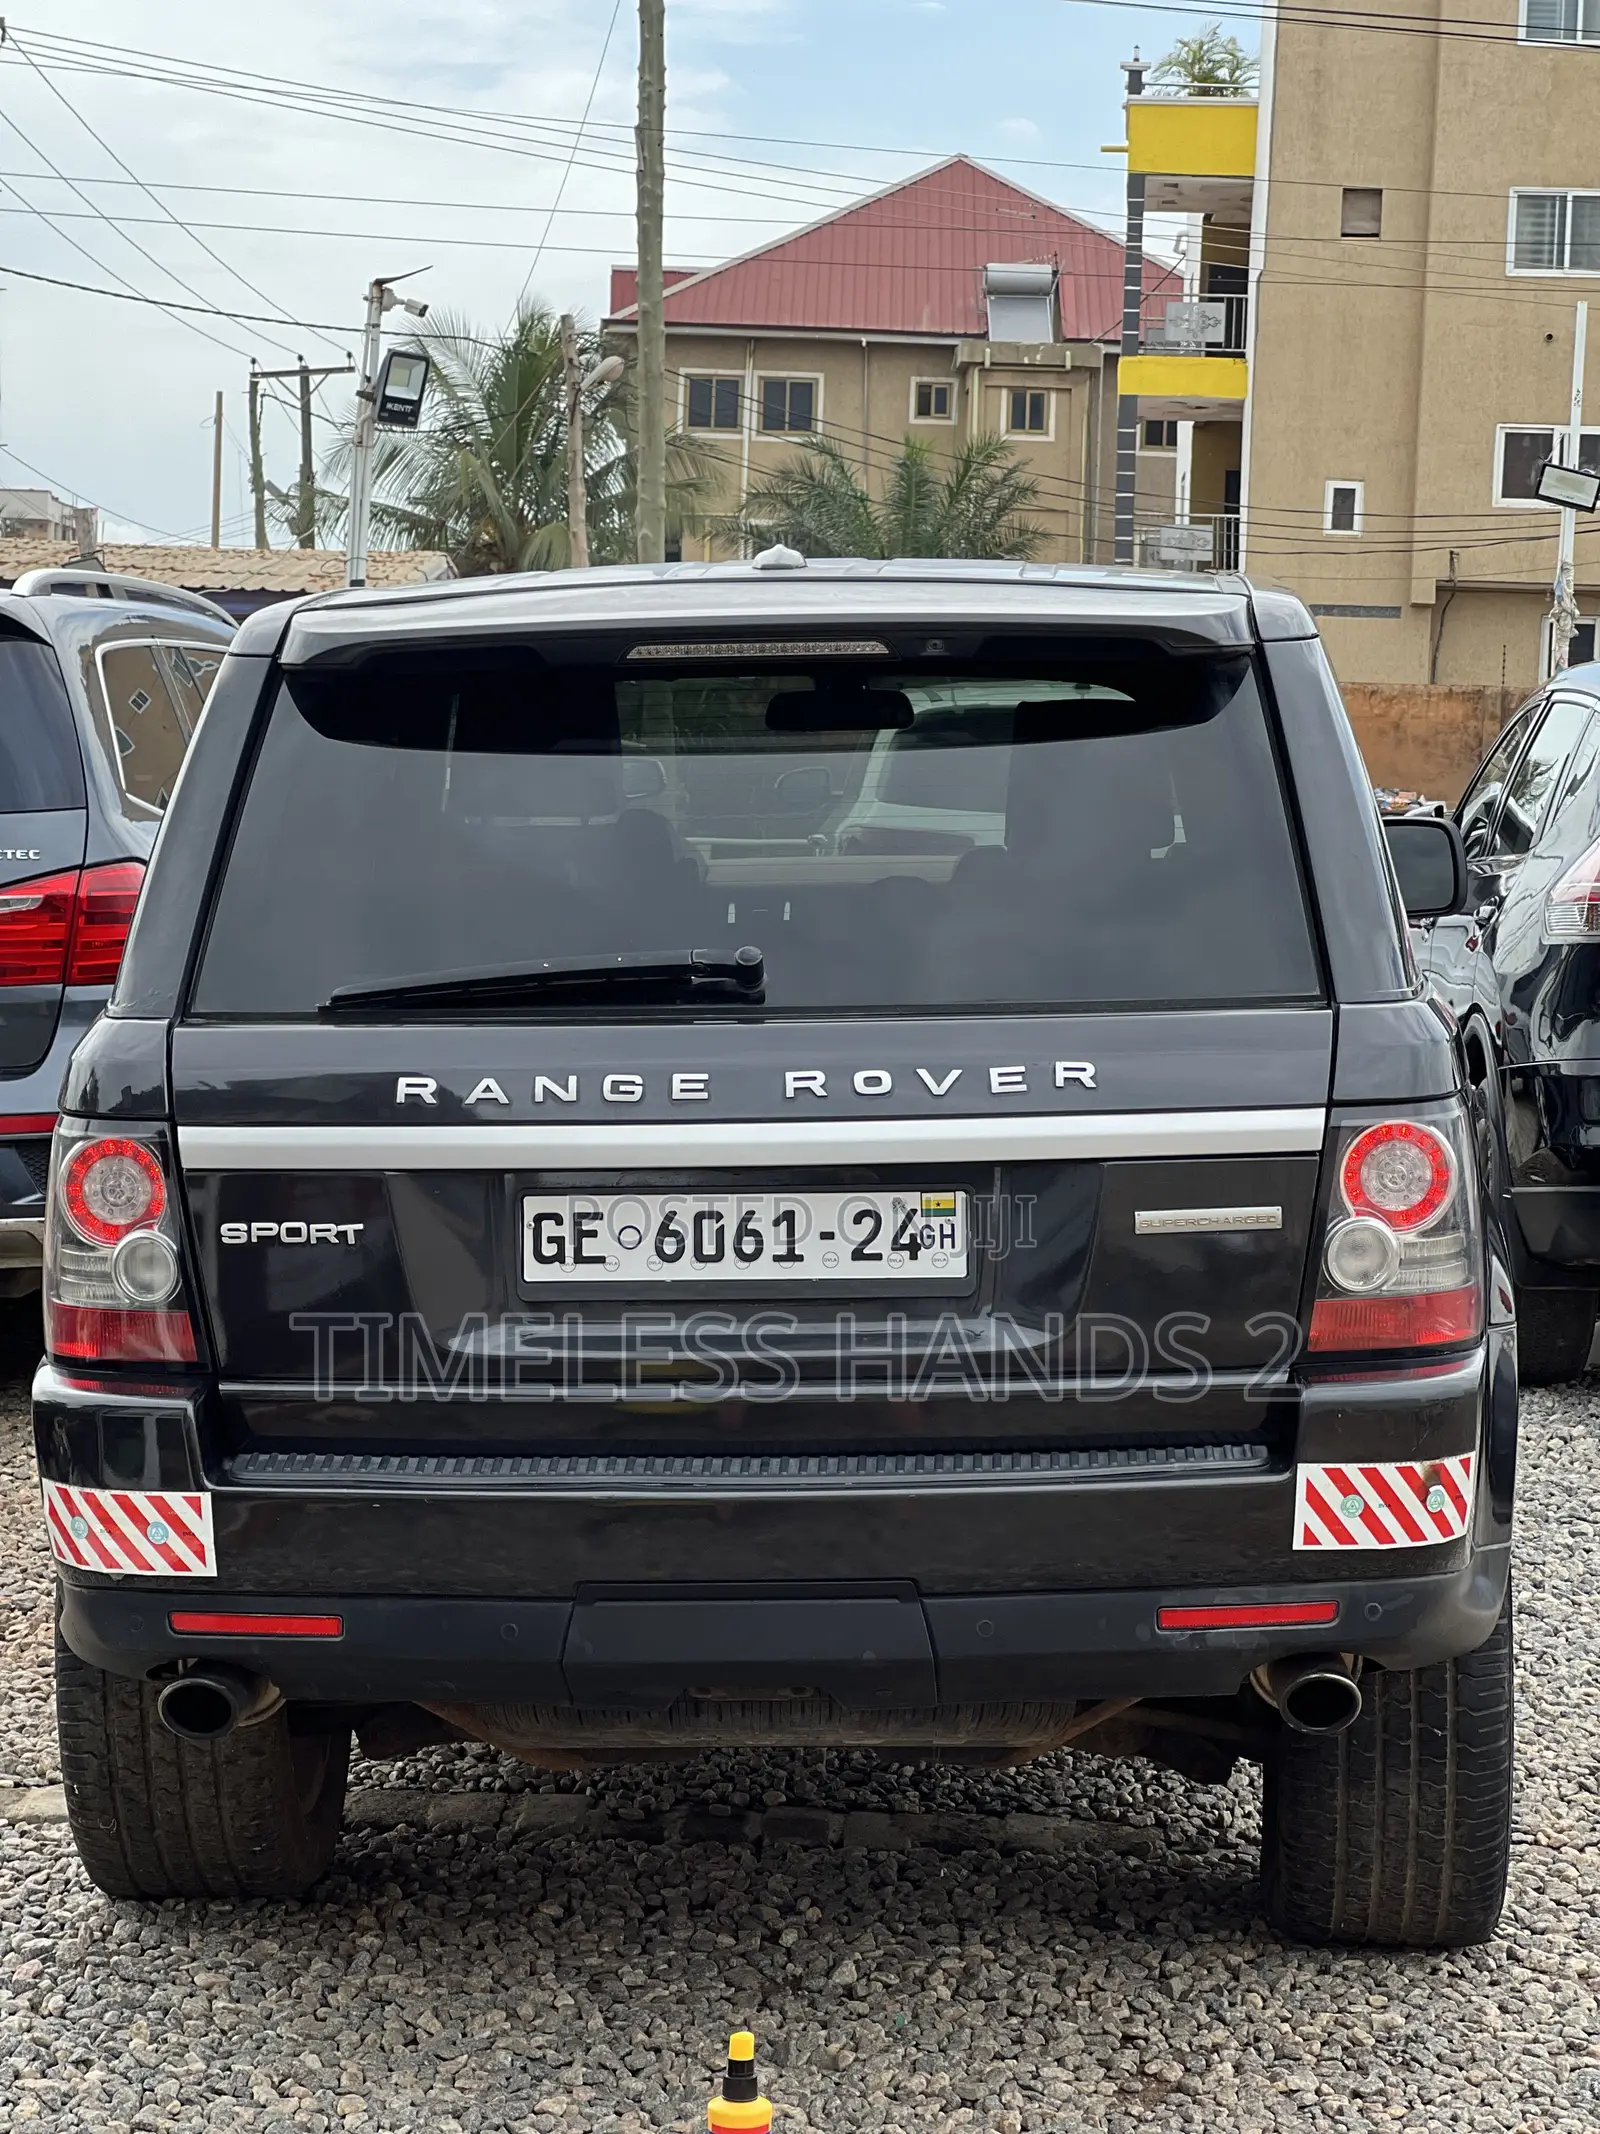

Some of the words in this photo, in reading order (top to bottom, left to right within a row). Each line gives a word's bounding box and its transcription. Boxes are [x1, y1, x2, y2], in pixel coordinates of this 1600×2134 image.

[0, 849, 40, 860] TEC
[395, 1073, 710, 1105] RANGE
[784, 1061, 1097, 1099] ROVER
[220, 1221, 364, 1245] SPORT
[1138, 1215, 1277, 1229] SUPERCHARGED
[532, 1211, 606, 1265] GE
[919, 1223, 955, 1250] GH
